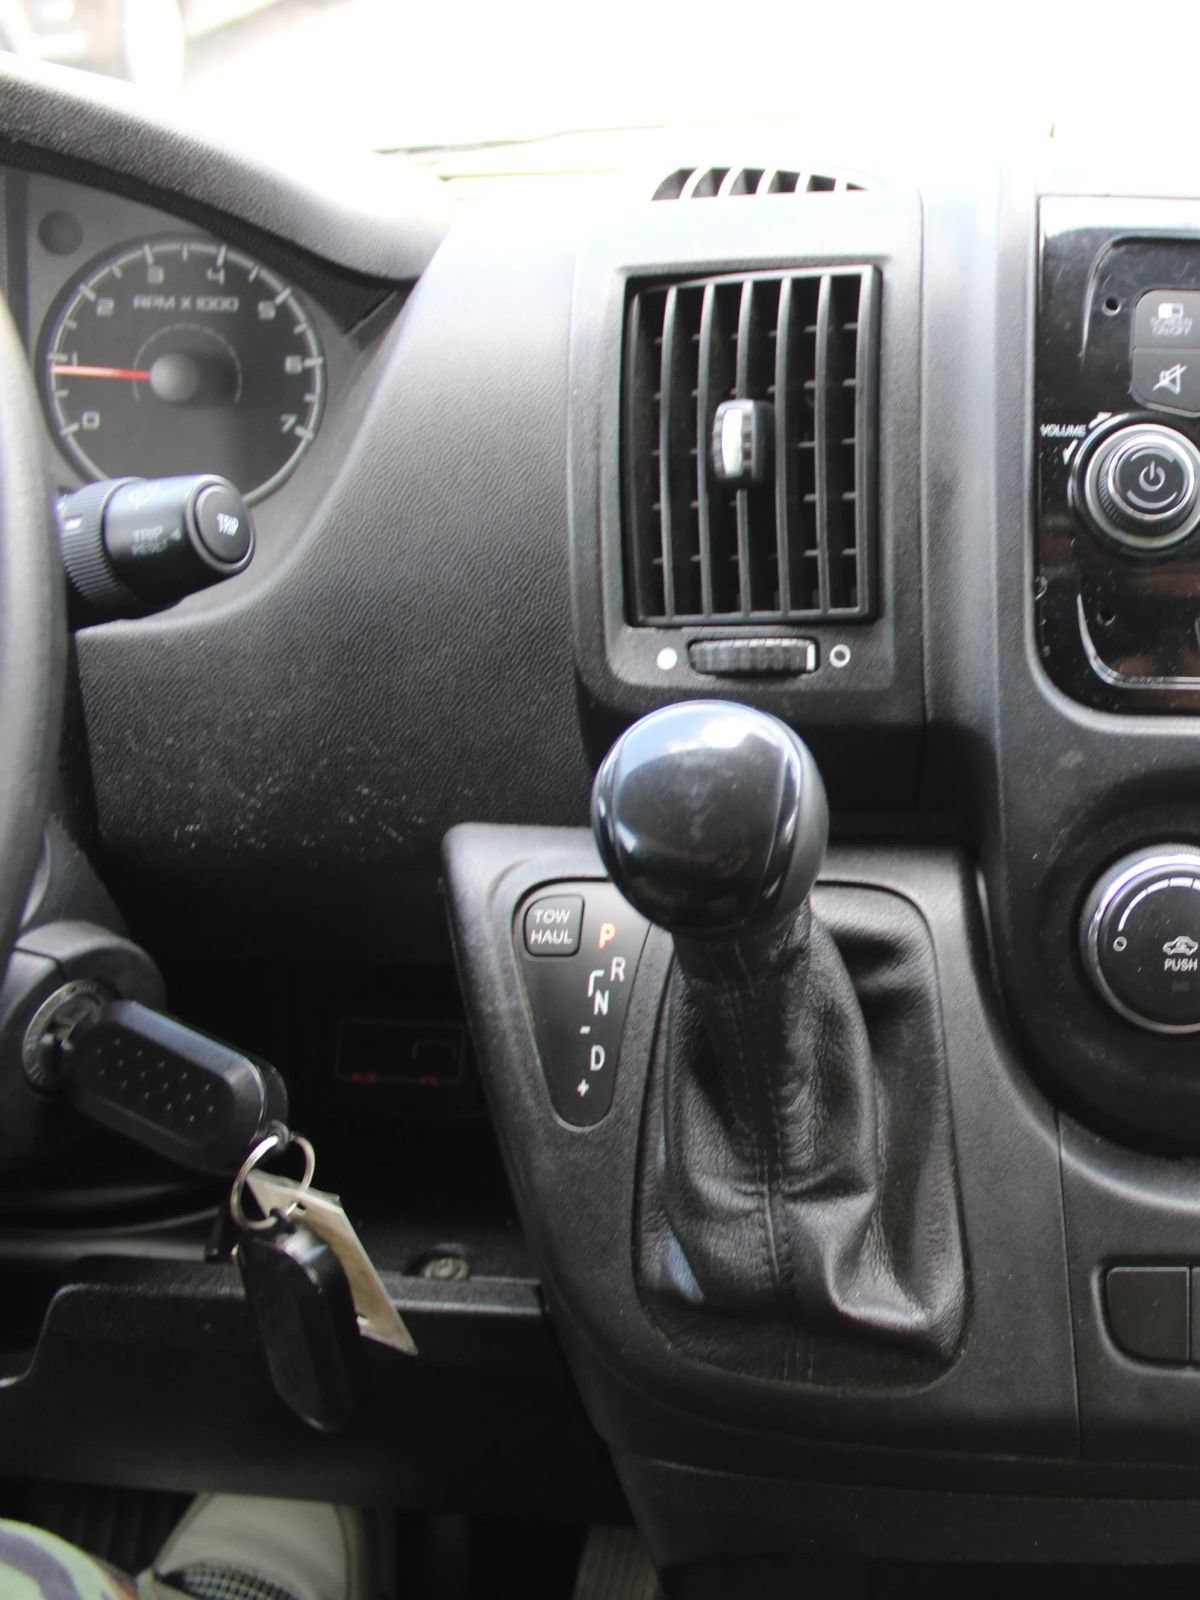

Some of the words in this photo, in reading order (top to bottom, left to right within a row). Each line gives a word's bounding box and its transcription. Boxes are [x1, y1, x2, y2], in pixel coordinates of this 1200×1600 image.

[207, 266, 226, 285] 4
[133, 295, 176, 311] RPM
[181, 295, 192, 311] X
[196, 295, 239, 312] 1000
[82, 411, 100, 430] 0
[280, 414, 297, 433] 7
[1040, 423, 1087, 438] VOLUME
[216, 512, 239, 537] TRIP
[534, 909, 571, 924] TOW
[530, 929, 573, 944] HAUL
[599, 923, 616, 949] P
[610, 956, 626, 982] R
[1164, 958, 1198, 972] PUSH
[594, 990, 610, 1016] N
[590, 1045, 606, 1071] D
